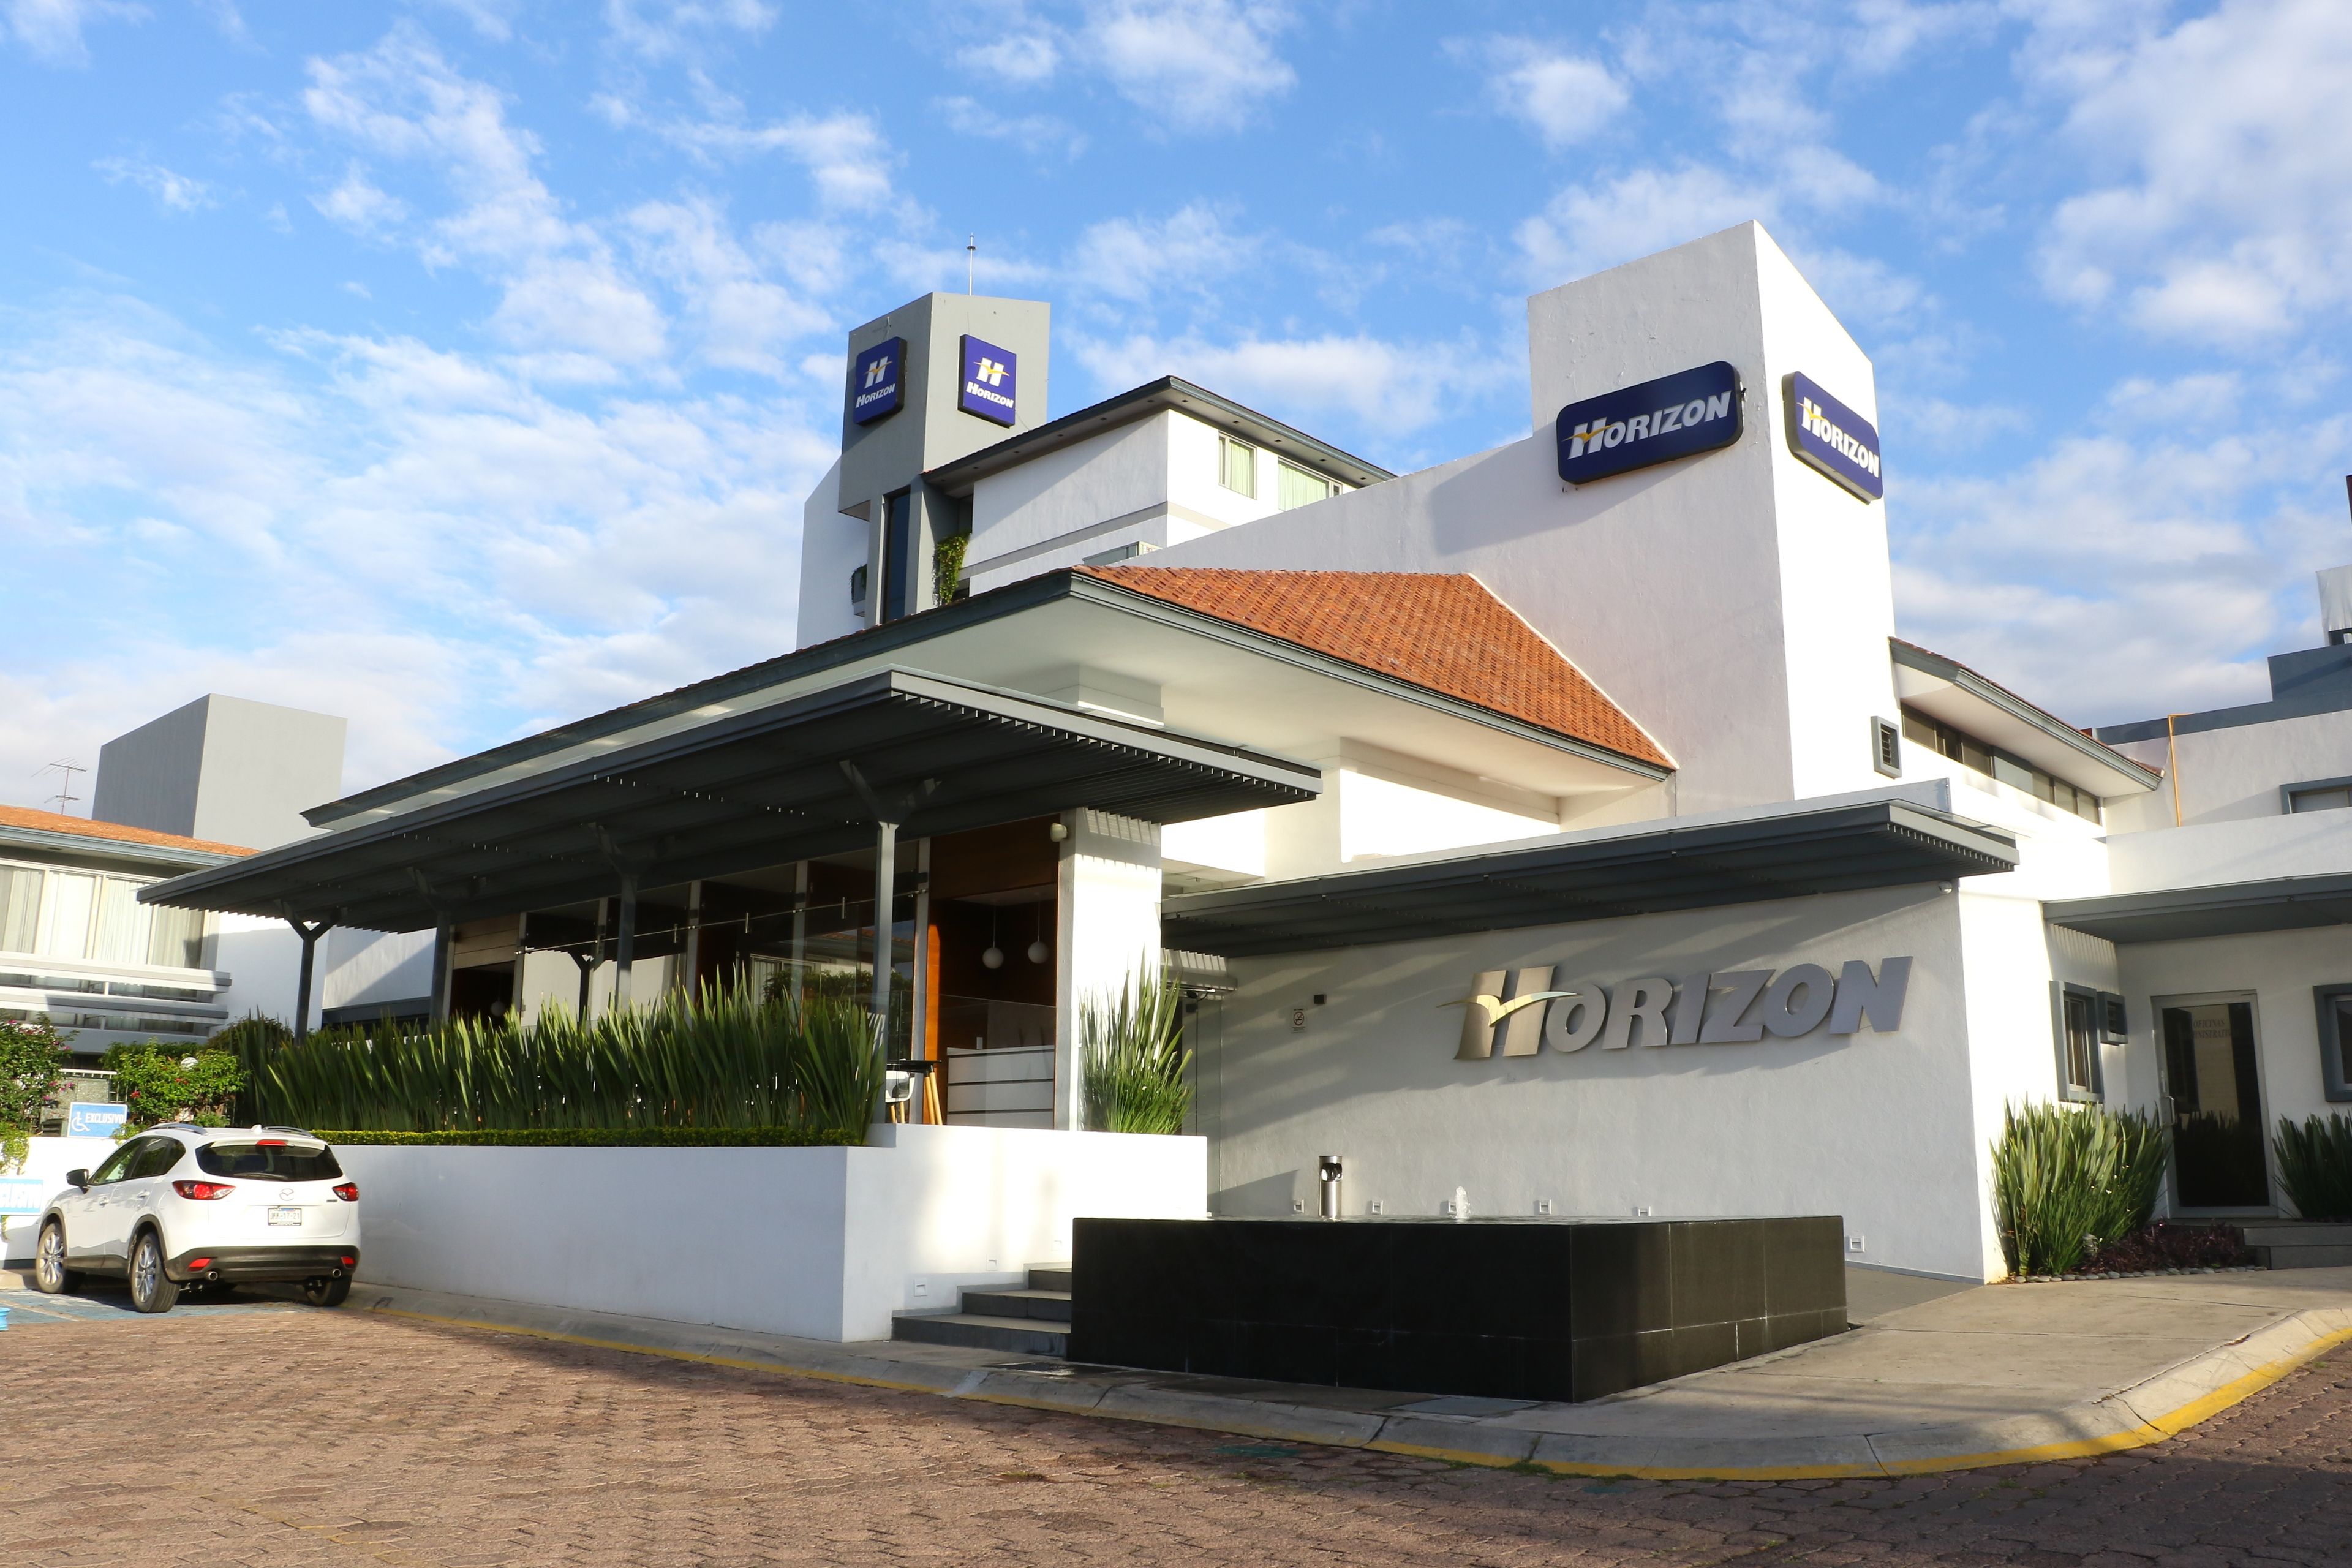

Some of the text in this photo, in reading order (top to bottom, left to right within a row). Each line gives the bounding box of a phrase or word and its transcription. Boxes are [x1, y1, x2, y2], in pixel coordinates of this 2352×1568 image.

[856, 383, 895, 409] HORIZON
[966, 381, 1014, 409] HORIZON
[1567, 390, 1732, 460] HORIZON
[1801, 396, 1880, 478] HORIZON
[1453, 956, 1913, 1061] HORIZON
[2193, 1019, 2225, 1028] OFICINAS
[85, 1112, 124, 1124] EXCLUSIVO
[0, 1183, 42, 1209] CLUSIVO
